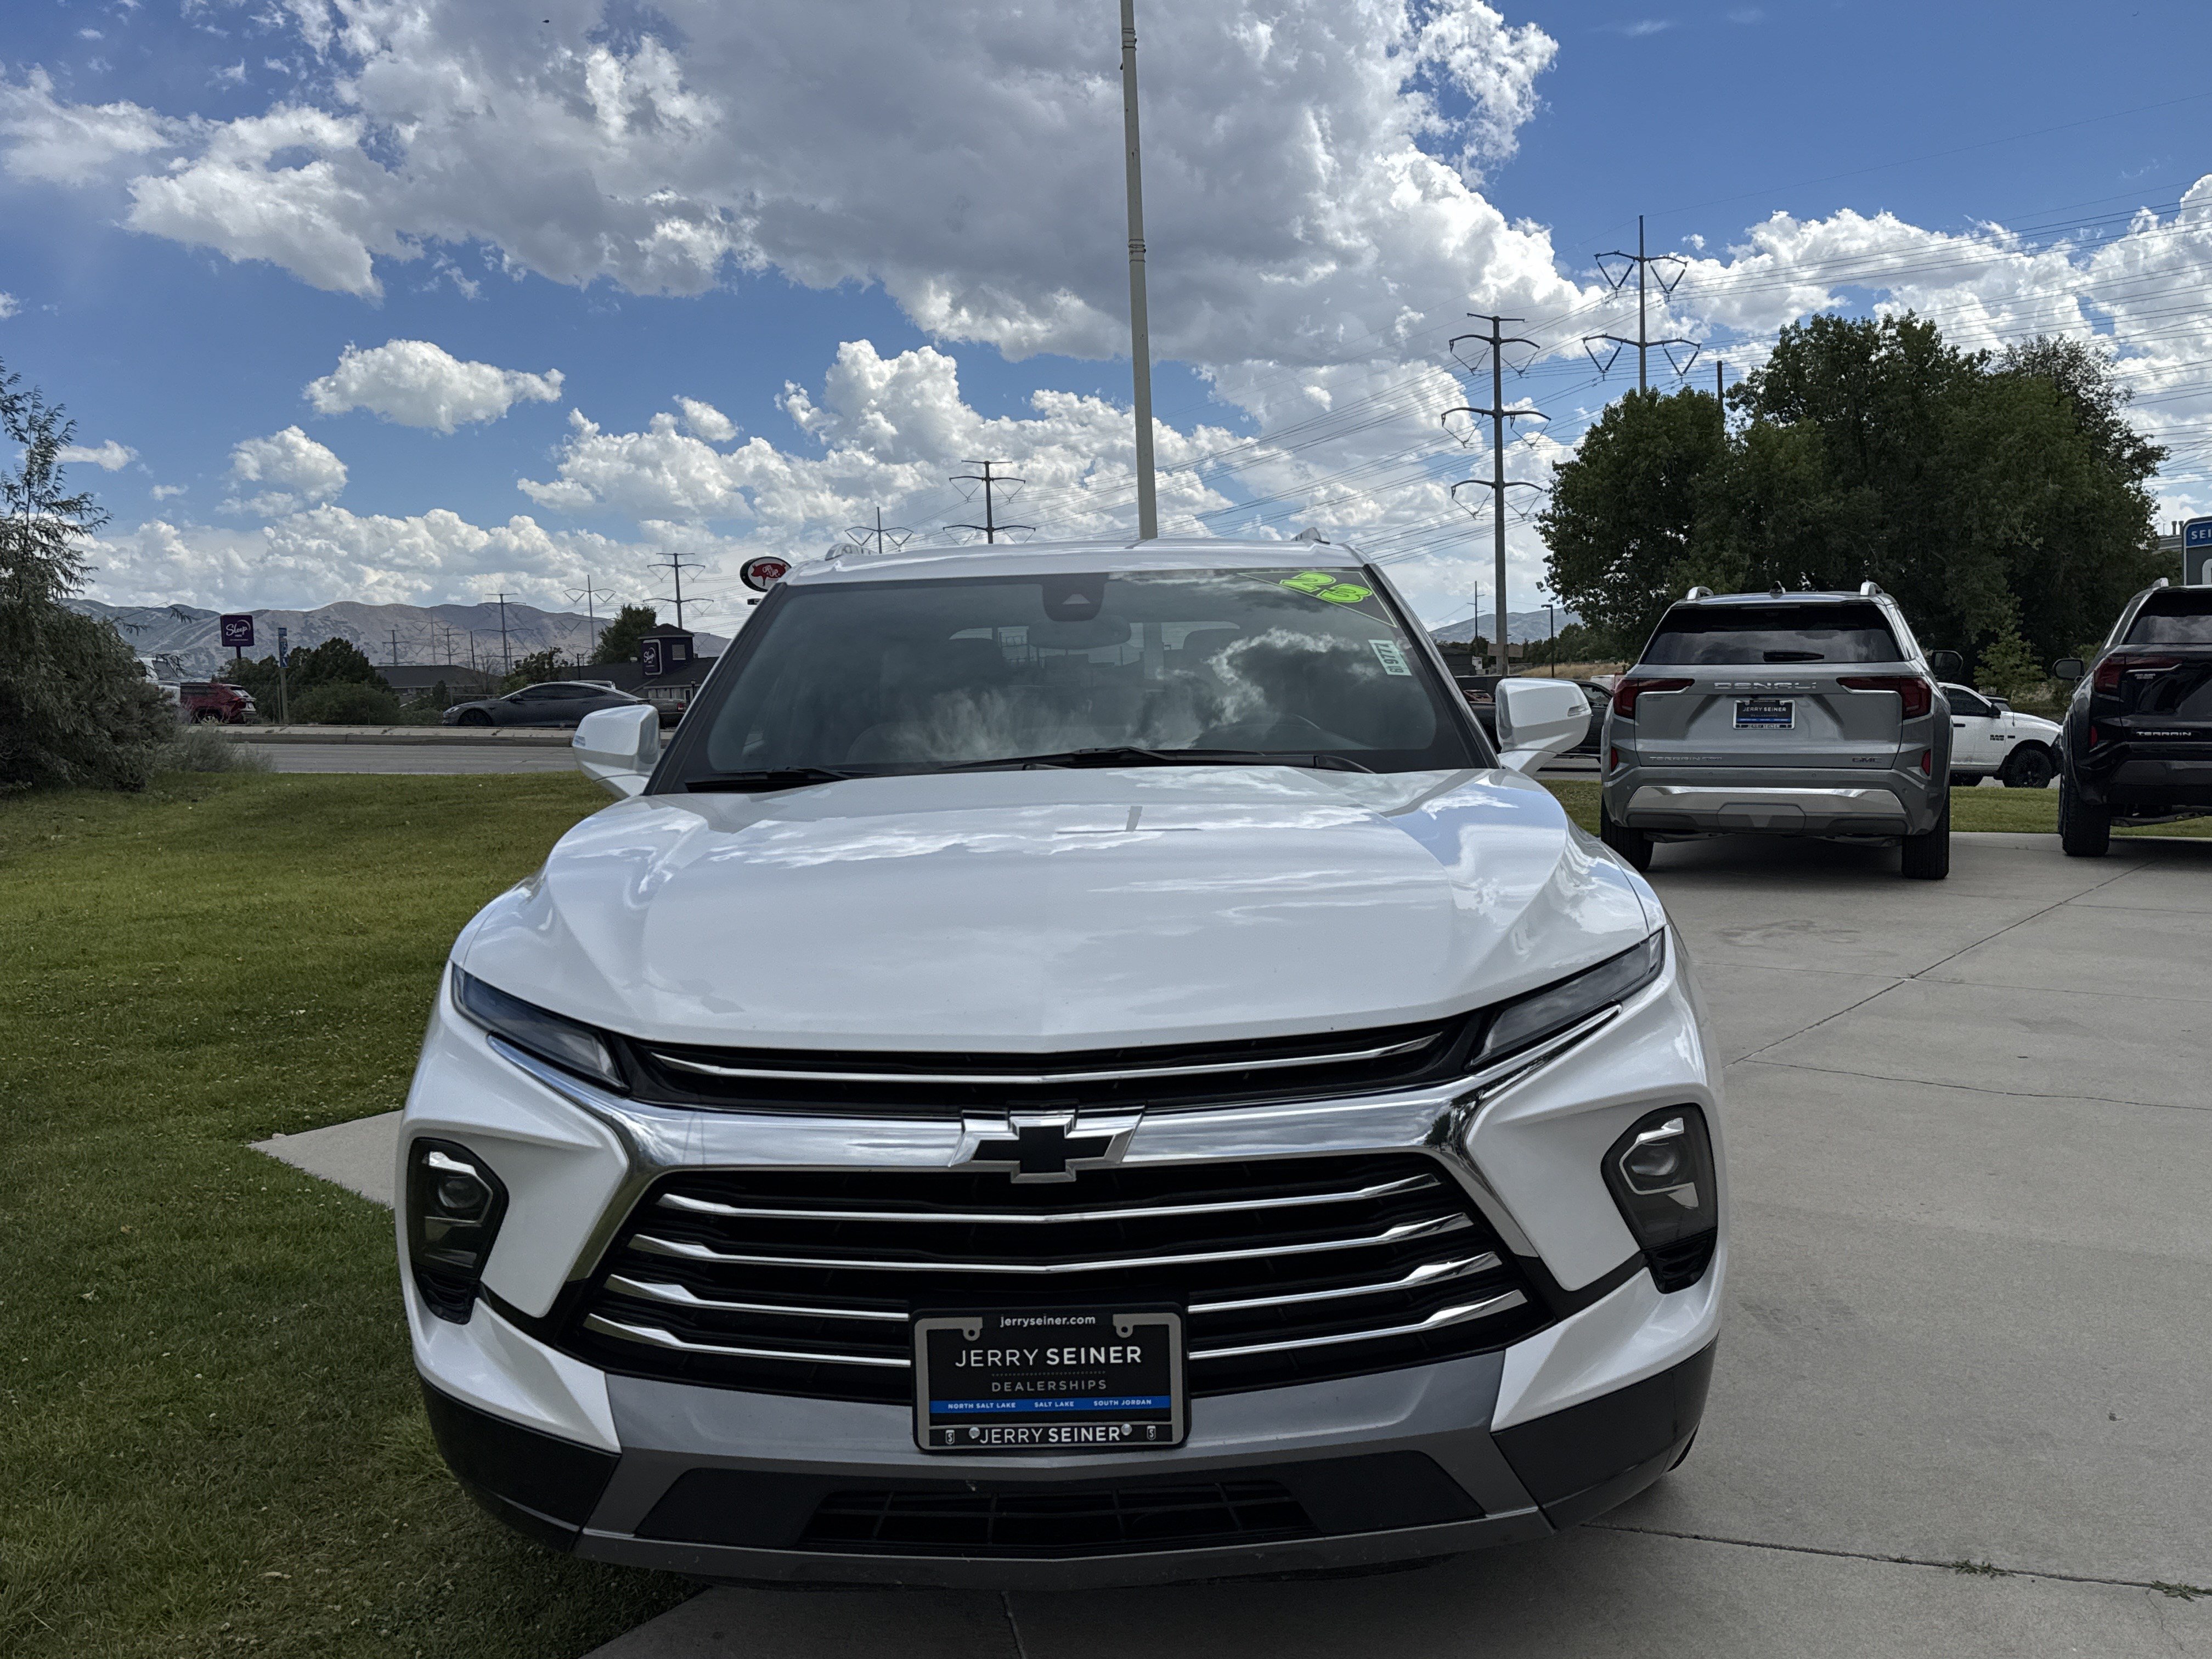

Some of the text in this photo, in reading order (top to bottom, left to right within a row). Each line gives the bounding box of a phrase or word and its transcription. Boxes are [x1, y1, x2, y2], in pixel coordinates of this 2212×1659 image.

[1279, 571, 1373, 603] 23
[1000, 1314, 1096, 1328] jerryseiner.com
[955, 1346, 1142, 1368] JERRY SEINER
[991, 1379, 1107, 1392] DEALERSHIPS
[979, 1428, 1043, 1444] JERRY
[1048, 1426, 1120, 1442] SEINER
